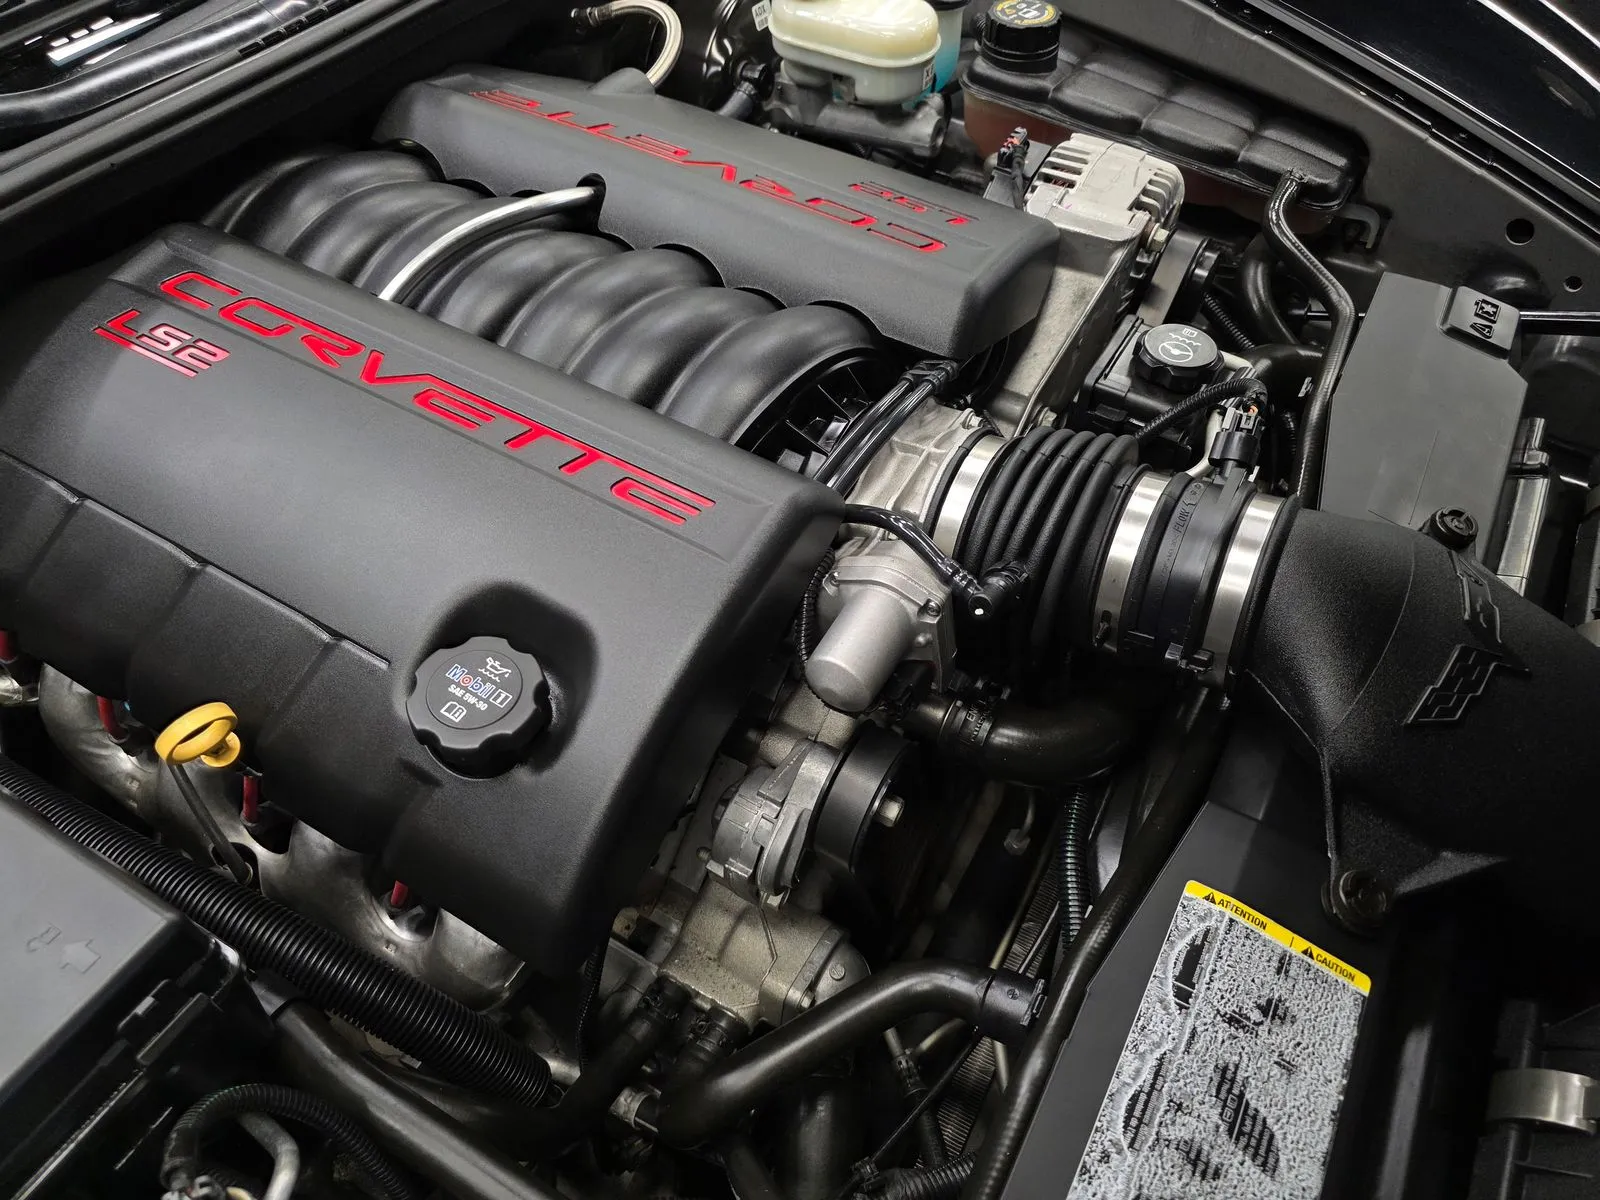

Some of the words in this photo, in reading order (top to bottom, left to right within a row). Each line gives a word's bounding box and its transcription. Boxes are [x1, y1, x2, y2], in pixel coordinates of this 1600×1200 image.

[468, 89, 948, 253] CORVETTE
[103, 309, 231, 372] LS2
[160, 270, 717, 525] CORVETTE
[1174, 508, 1192, 534] FLOW
[445, 664, 496, 699] Mobil
[448, 684, 465, 698] SAE
[463, 692, 488, 711] 5W-30
[1217, 898, 1268, 931] ATTENTION
[1315, 952, 1356, 983] CAUTION
